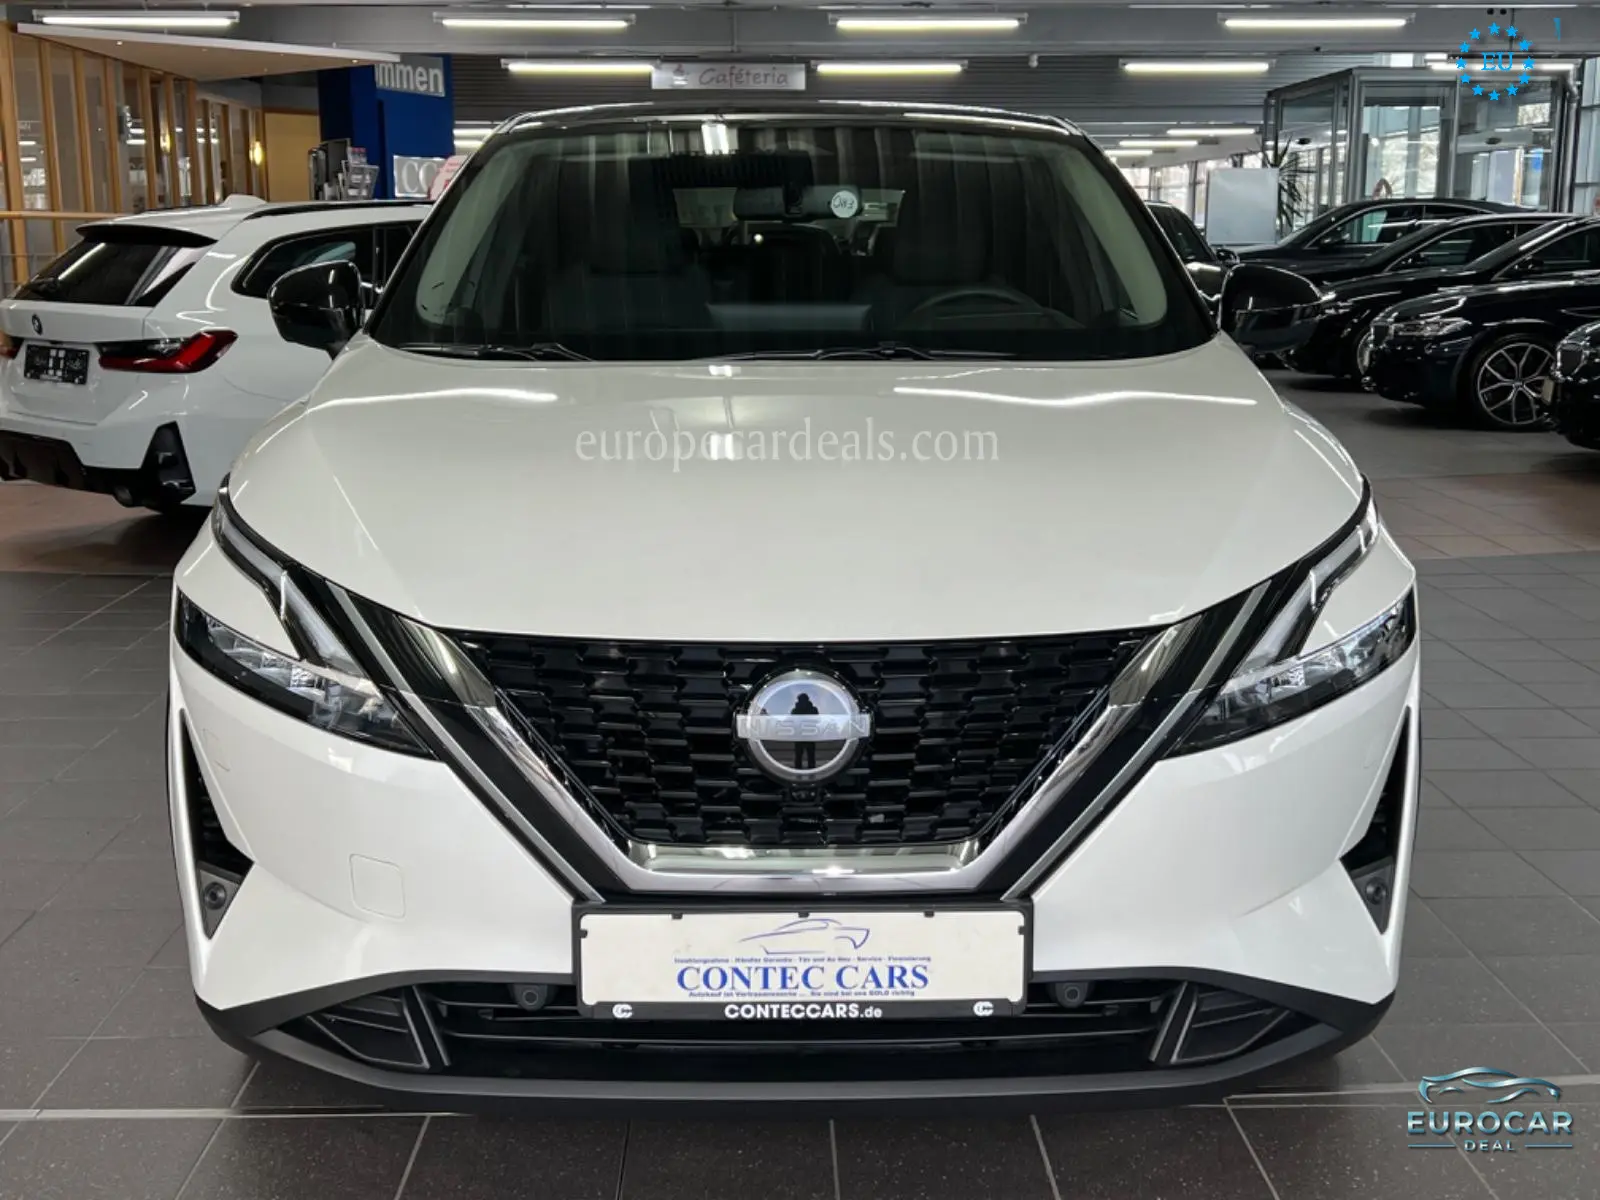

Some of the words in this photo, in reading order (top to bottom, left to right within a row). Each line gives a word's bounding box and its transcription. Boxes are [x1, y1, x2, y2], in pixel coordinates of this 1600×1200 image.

[374, 63, 443, 93] mmen
[677, 965, 825, 990] CONTEC
[836, 964, 929, 989] CARS
[724, 1003, 883, 1019] CONTECCARS.de
